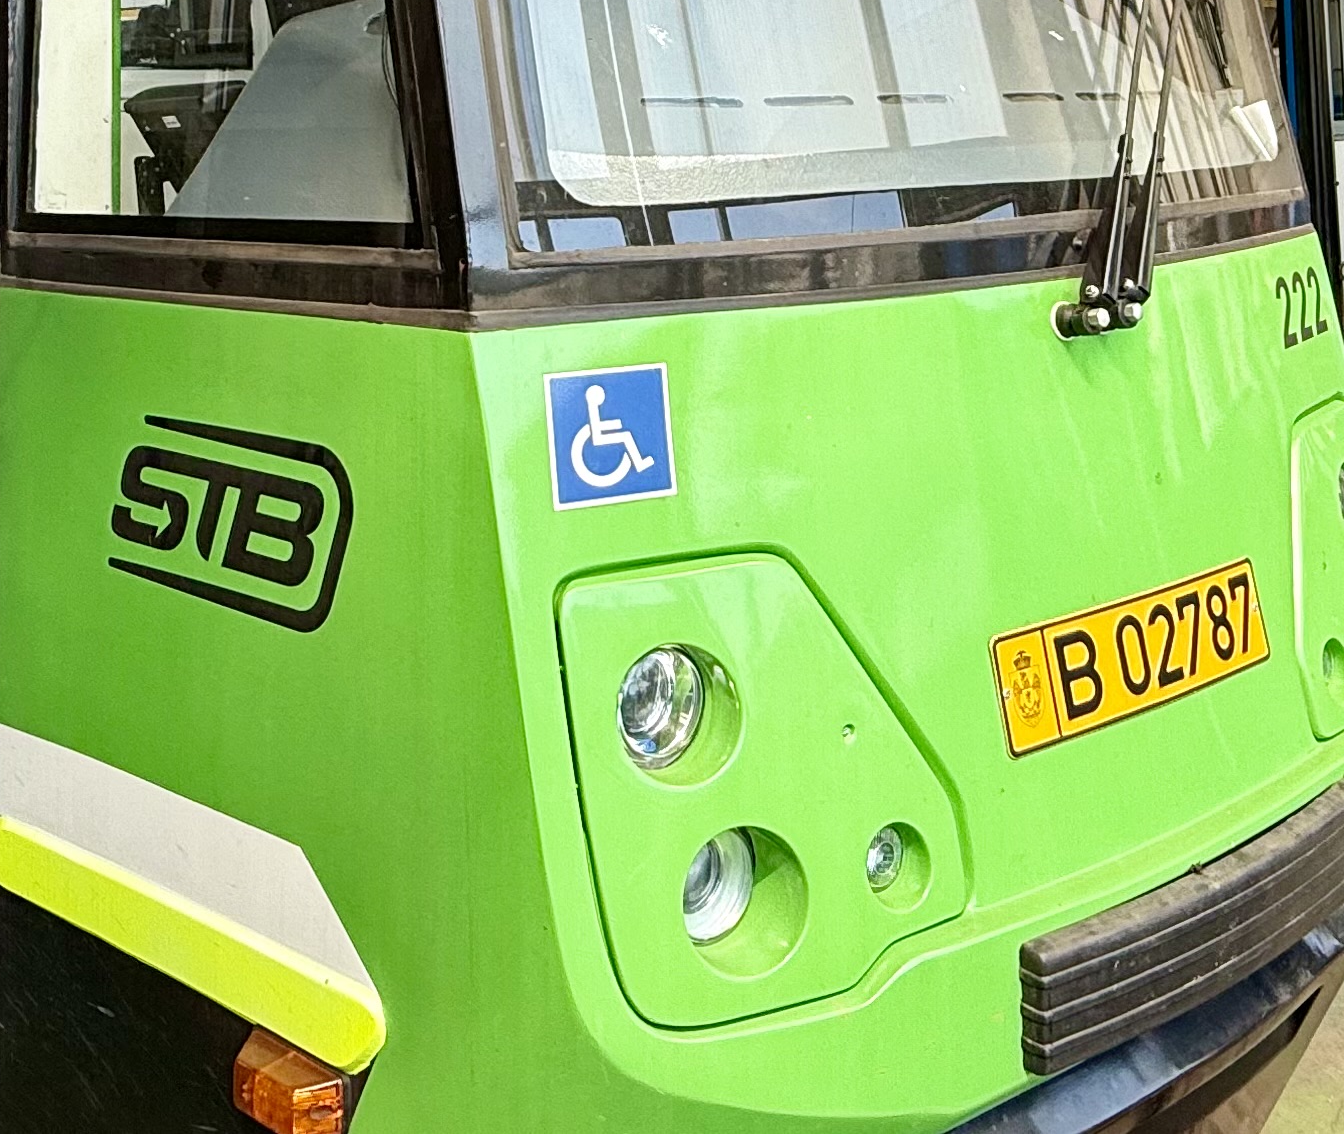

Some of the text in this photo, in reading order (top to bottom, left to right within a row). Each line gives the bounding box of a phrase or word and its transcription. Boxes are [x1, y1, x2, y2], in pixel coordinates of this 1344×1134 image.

[1275, 266, 1328, 349] 222
[111, 444, 325, 588] STB
[1052, 572, 1250, 722] B 02787
